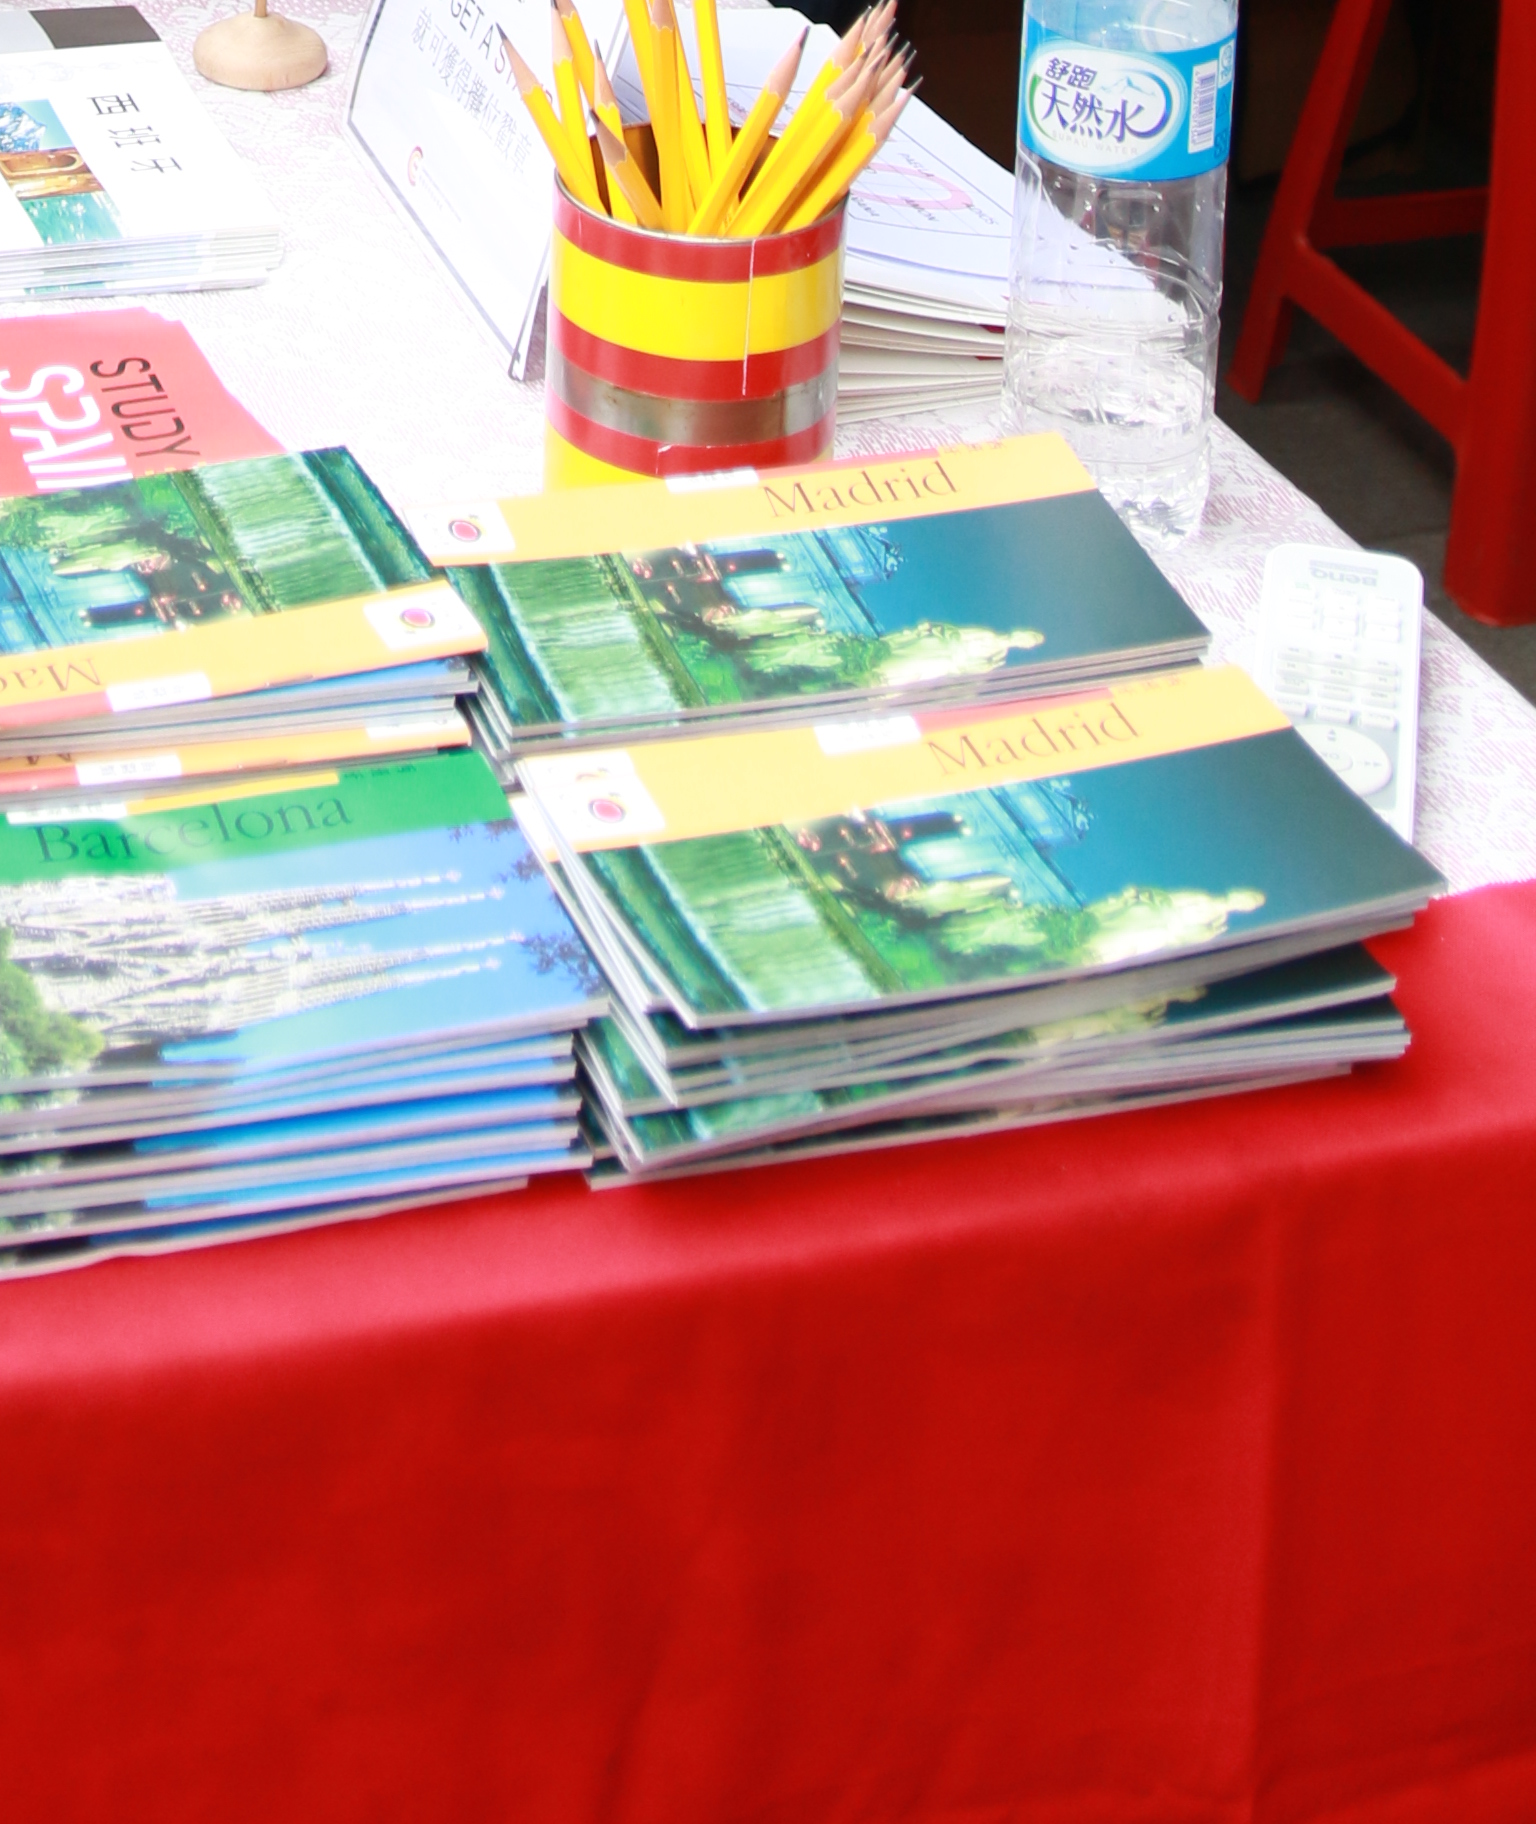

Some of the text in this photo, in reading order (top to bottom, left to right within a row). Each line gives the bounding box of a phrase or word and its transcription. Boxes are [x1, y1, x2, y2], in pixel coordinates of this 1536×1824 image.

[478, 23, 495, 61] A
[1045, 56, 1098, 91] 舒跑
[86, 92, 182, 173] 西班牙
[1041, 79, 1146, 143] 天然水
[90, 356, 201, 457] STUDY
[760, 459, 959, 519] Madrid
[925, 701, 1142, 777] Madrid
[31, 795, 355, 864] Barcelona
